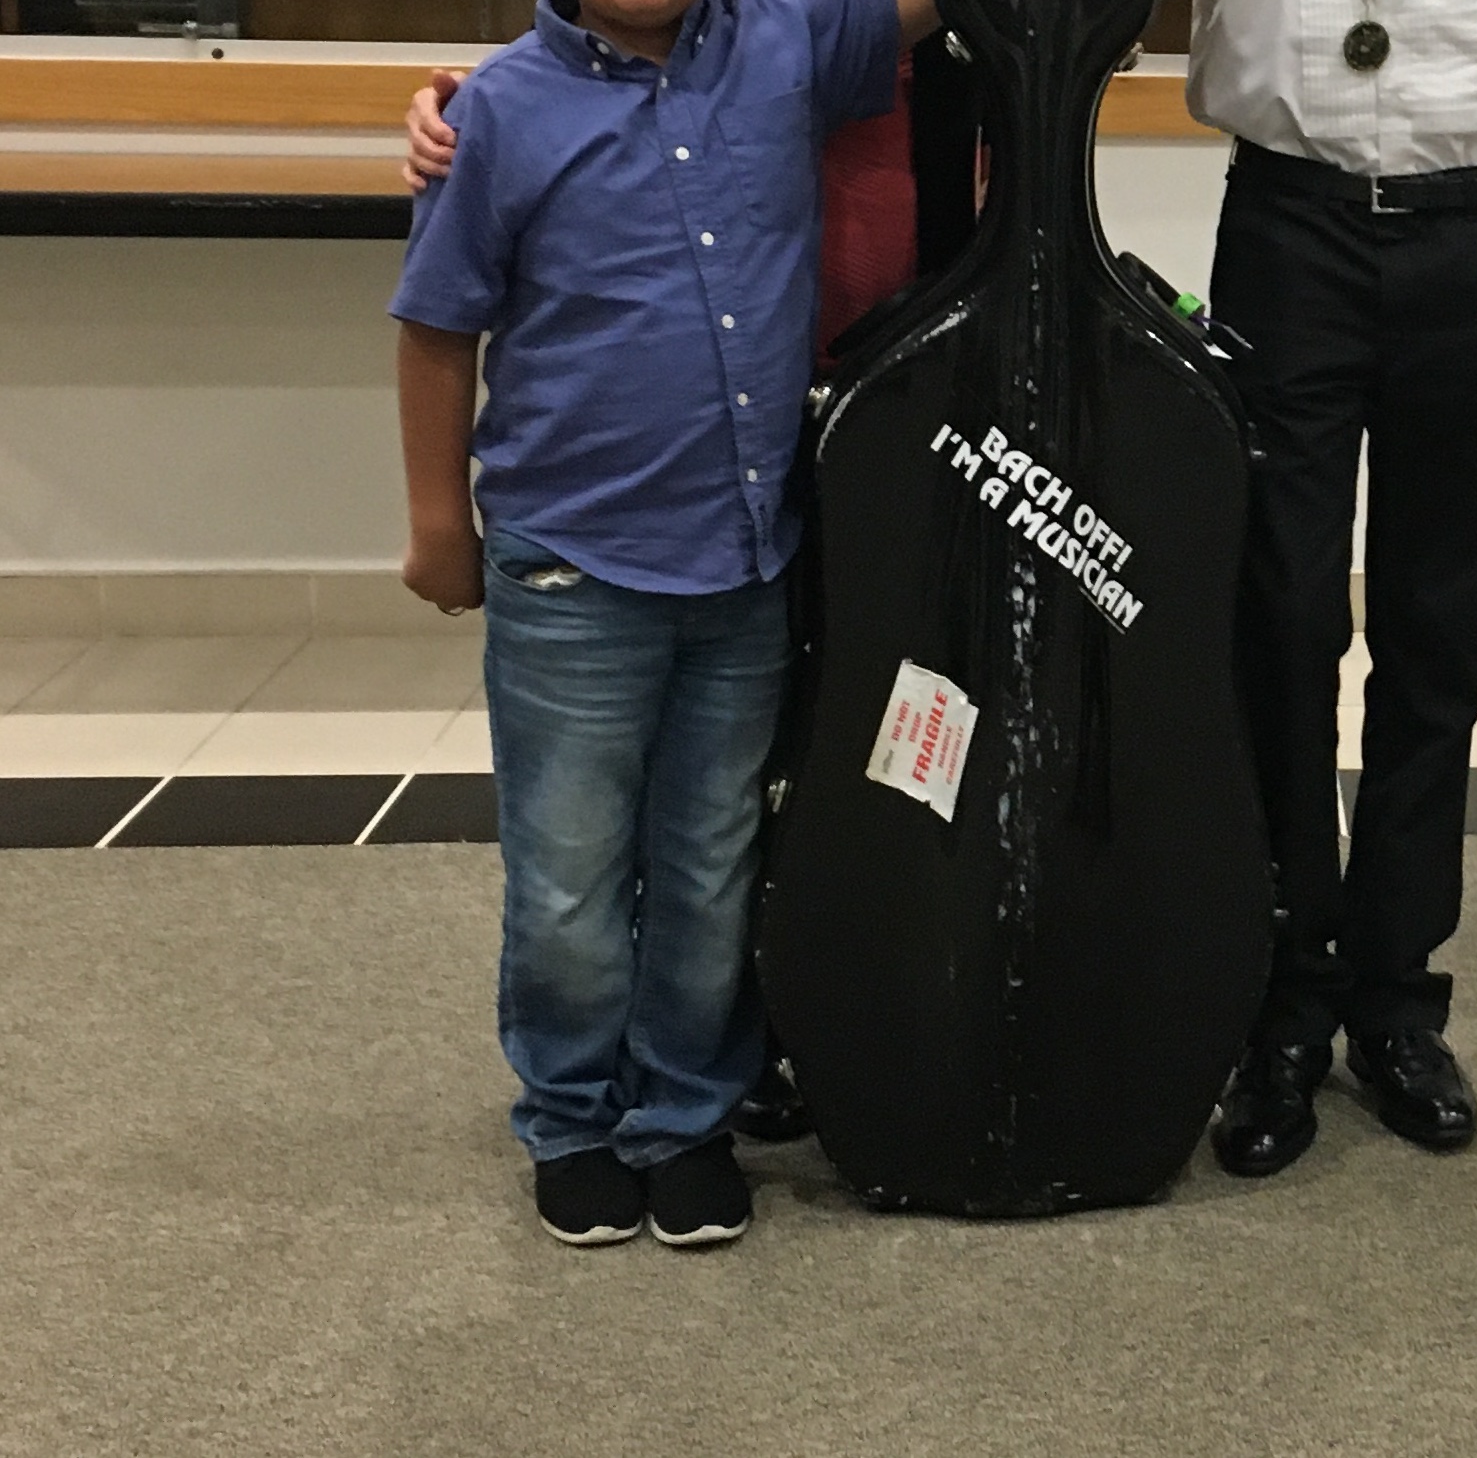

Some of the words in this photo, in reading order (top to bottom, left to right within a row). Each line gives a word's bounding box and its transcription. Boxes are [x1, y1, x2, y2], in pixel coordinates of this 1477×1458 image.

[930, 423, 983, 482] I'M
[979, 477, 1010, 510] A
[1006, 498, 1144, 628] MUSICIAN
[980, 425, 1073, 515] BACH
[1073, 503, 1133, 573] OFF!
[897, 699, 910, 723] NOT
[908, 711, 922, 743] DROP
[912, 688, 948, 784] FRAGILE
